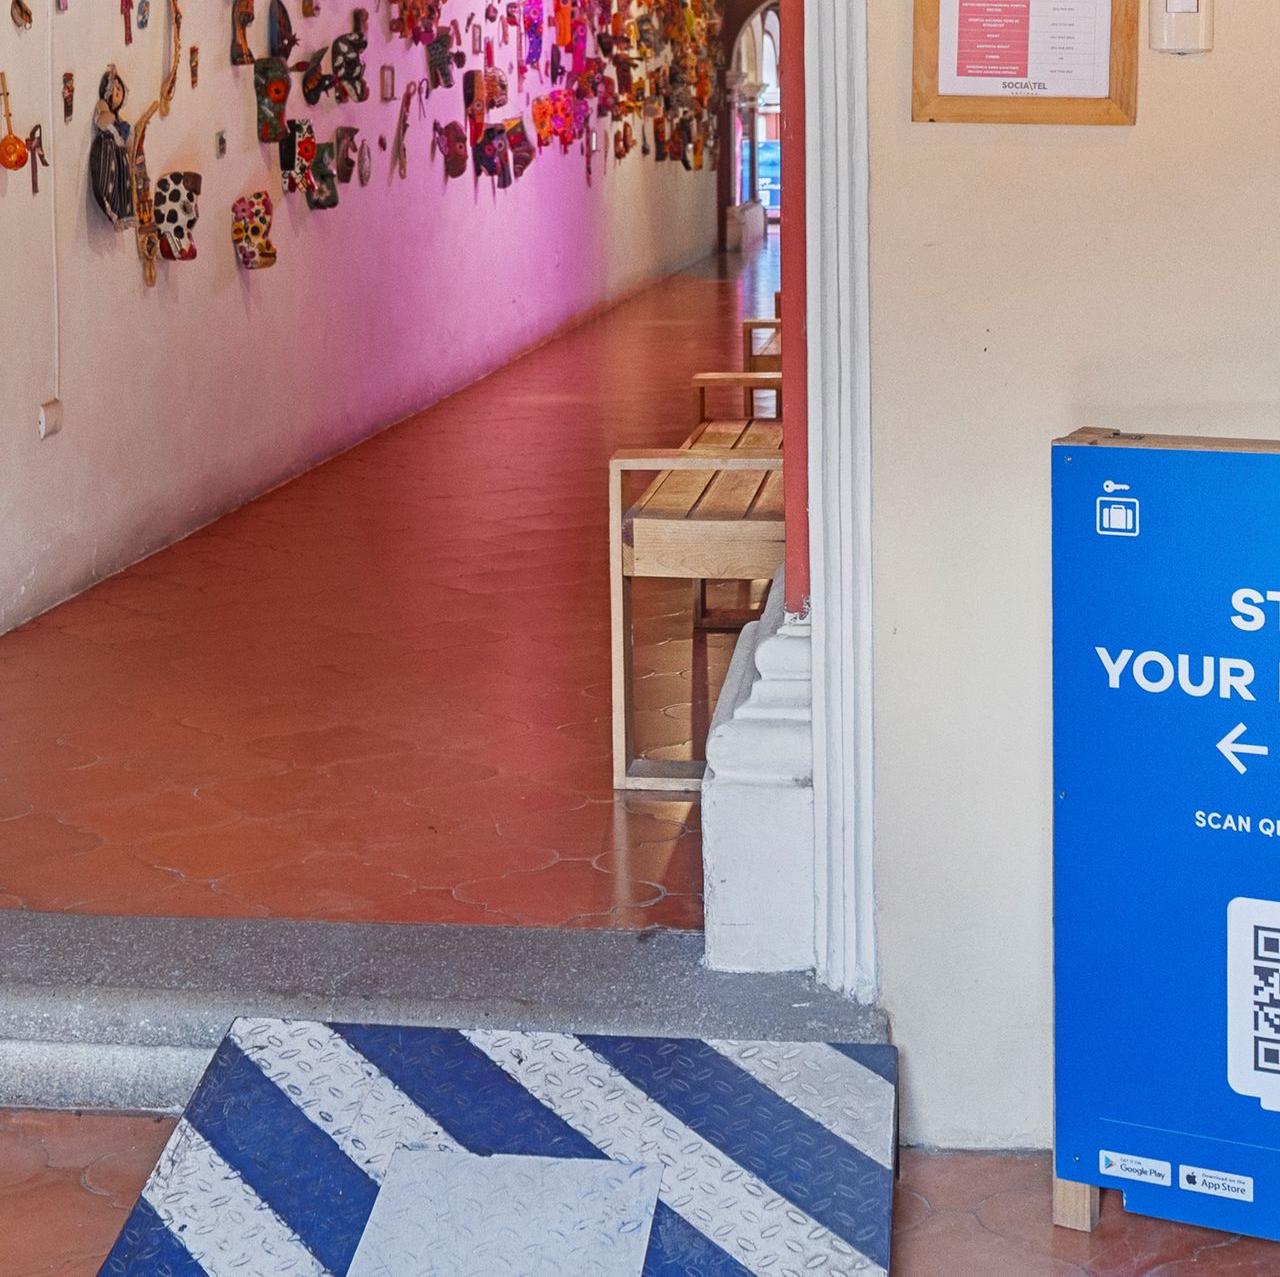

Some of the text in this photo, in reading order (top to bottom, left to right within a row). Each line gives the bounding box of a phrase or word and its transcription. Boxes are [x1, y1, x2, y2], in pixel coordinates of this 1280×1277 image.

[1095, 647, 1257, 701] YOUR
[1194, 810, 1251, 834] SCAN
[1120, 1164, 1165, 1180] Google Play
[1201, 1180, 1246, 1195] App Store
